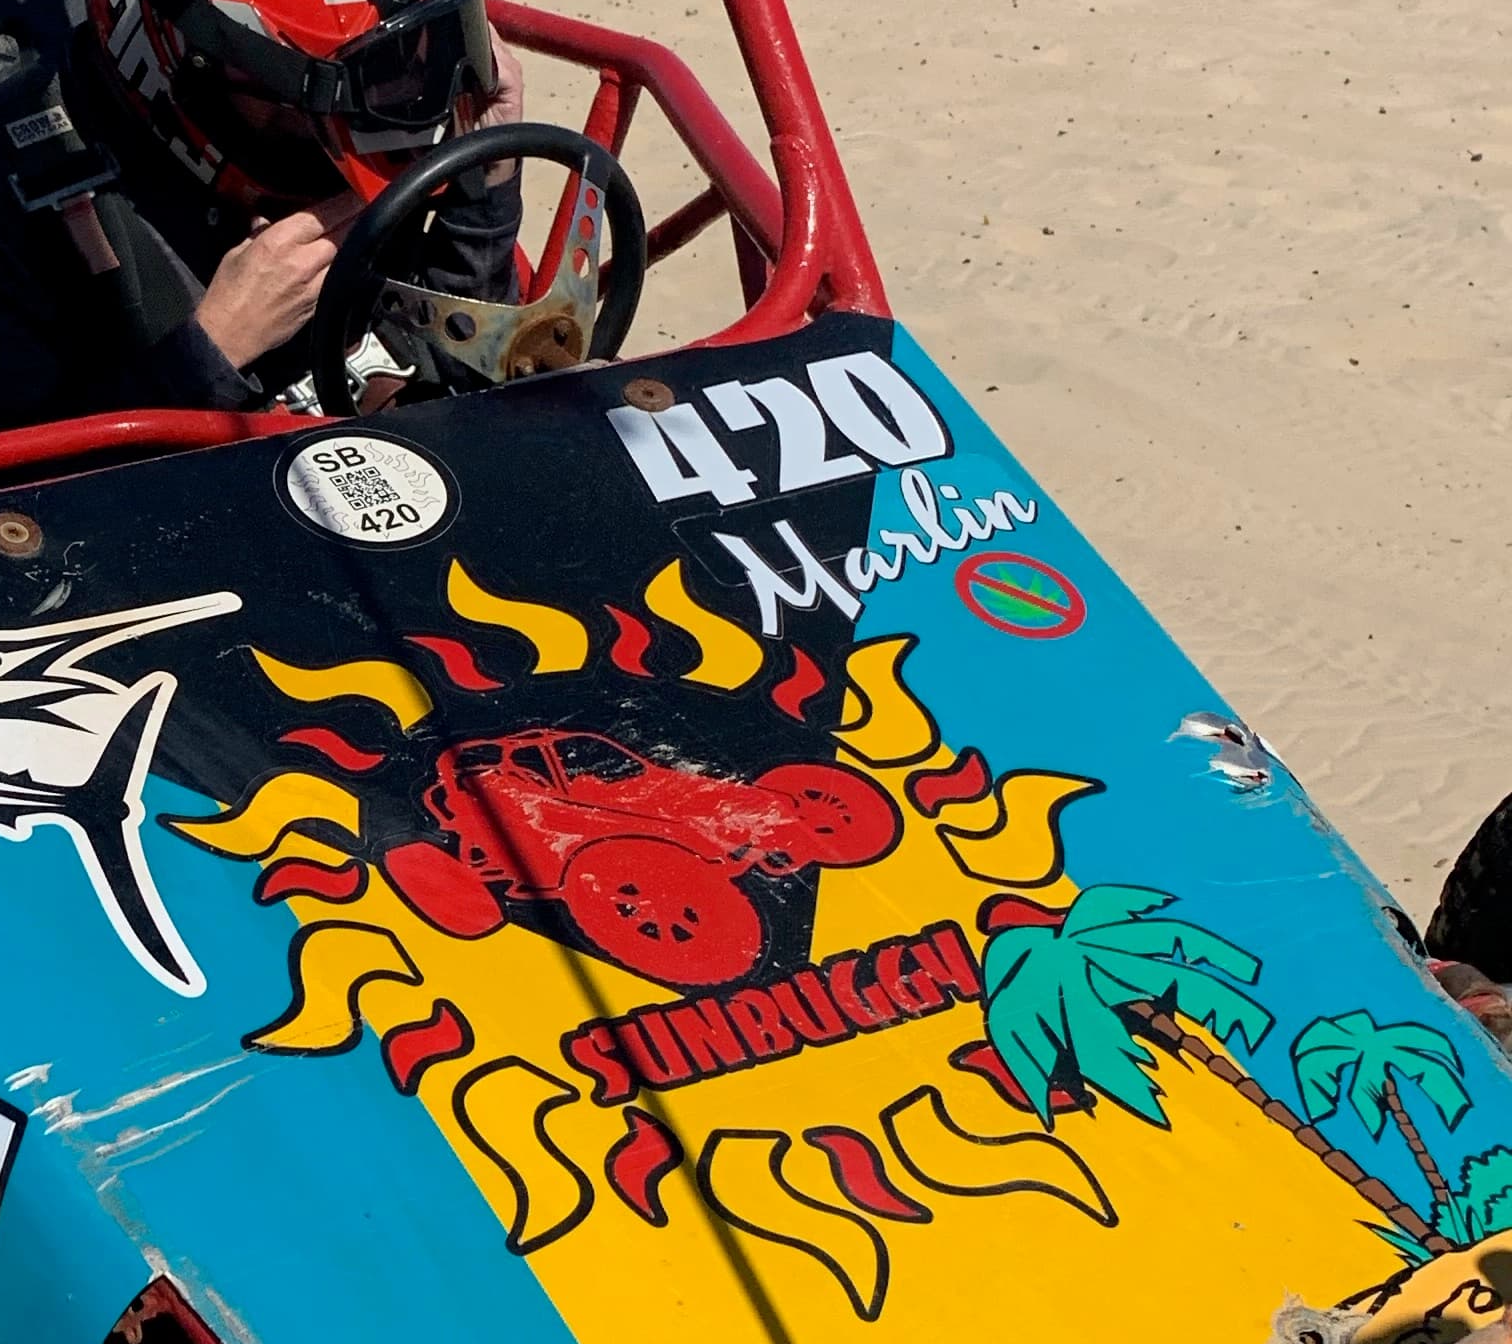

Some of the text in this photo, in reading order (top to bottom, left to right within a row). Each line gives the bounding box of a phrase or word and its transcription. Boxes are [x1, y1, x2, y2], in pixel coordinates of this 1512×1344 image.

[312, 446, 367, 473] SB
[605, 351, 948, 506] 420
[360, 503, 421, 533] 420
[711, 467, 1037, 638] Marlin
[564, 923, 984, 1104] SUNBUGGY
